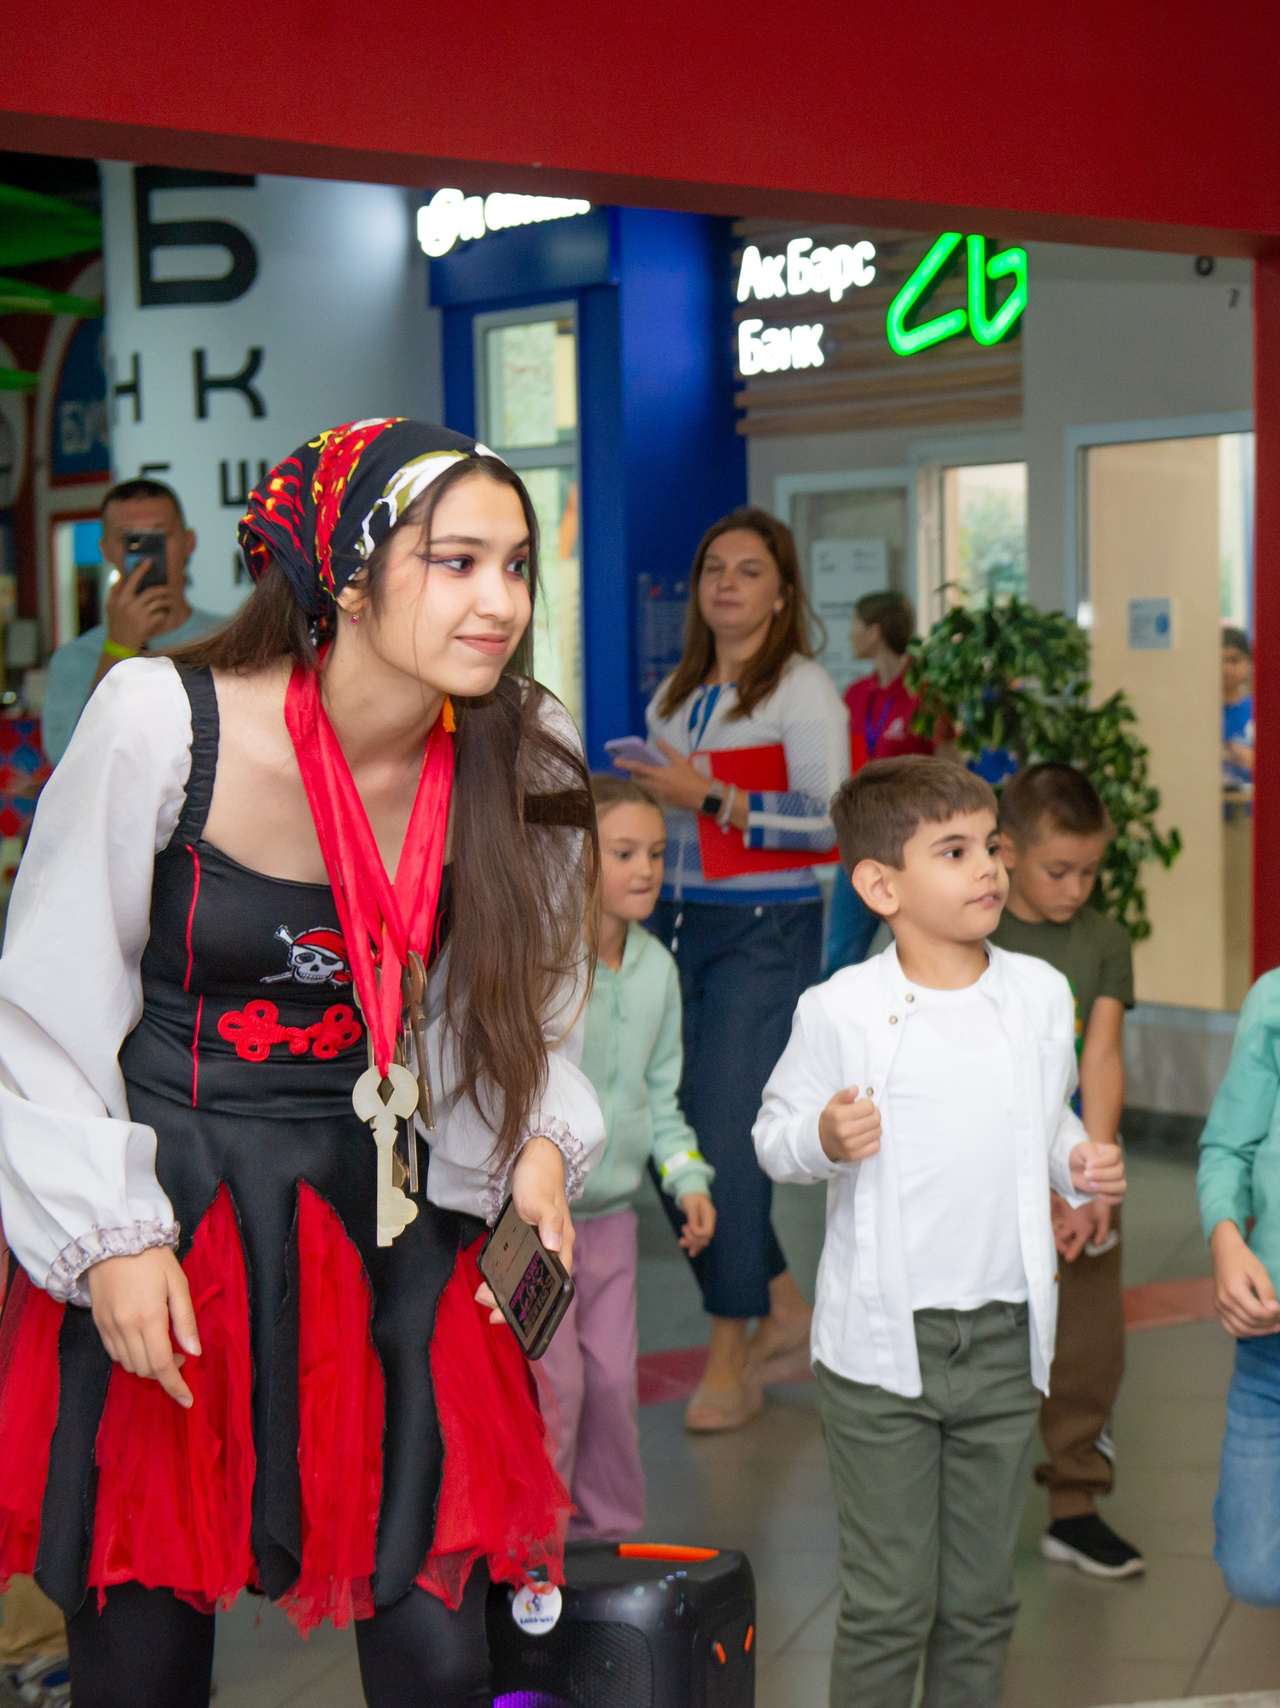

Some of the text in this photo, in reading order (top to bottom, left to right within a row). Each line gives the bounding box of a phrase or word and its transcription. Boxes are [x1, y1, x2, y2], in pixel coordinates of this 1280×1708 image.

[133, 164, 259, 307] Б
[194, 346, 267, 419] К
[738, 318, 825, 376] Банк
